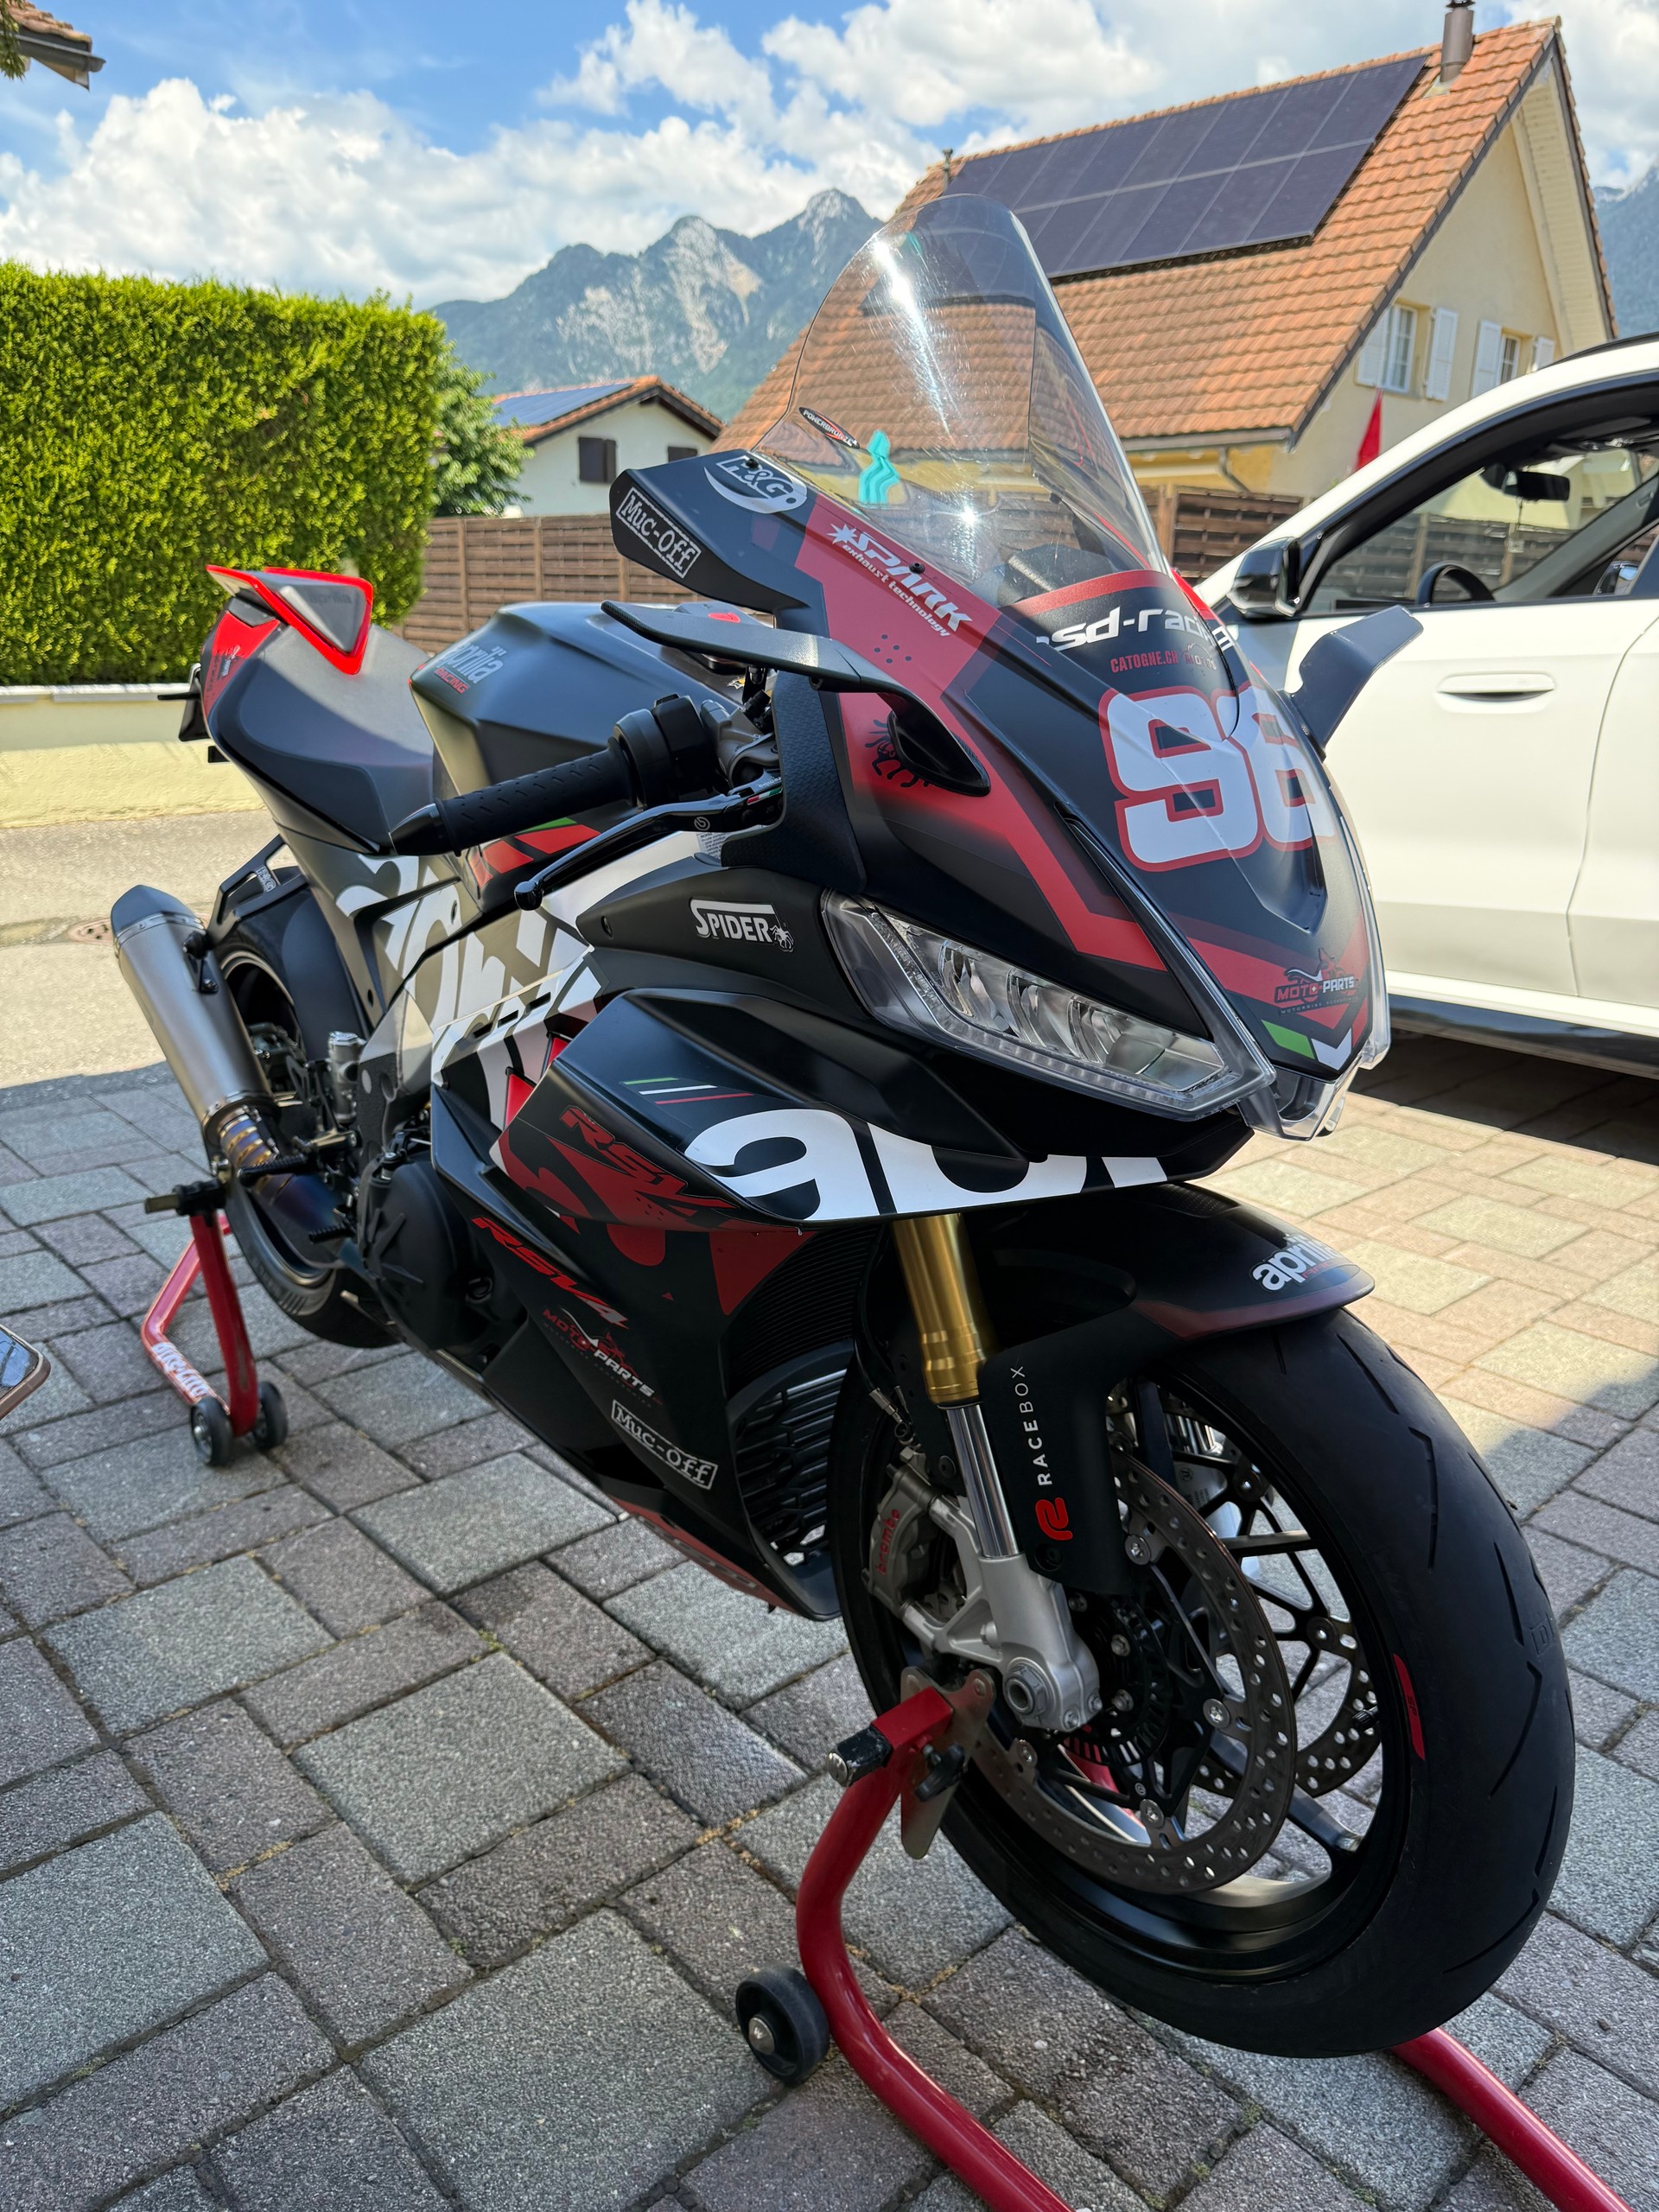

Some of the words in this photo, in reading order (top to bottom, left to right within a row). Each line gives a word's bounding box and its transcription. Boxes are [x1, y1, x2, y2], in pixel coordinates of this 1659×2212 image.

[803, 409, 854, 447] POWERBRONZE
[621, 493, 696, 571] Muc-Off
[842, 544, 890, 583] exhaust
[888, 581, 950, 637] technology
[843, 531, 973, 632] SPARK
[434, 667, 469, 694] RACING
[1110, 650, 1178, 674] CATOGNE.CH
[690, 899, 777, 943] SPIDER
[615, 1406, 712, 1484] Muc-Off
[875, 1509, 900, 1576] brembo
